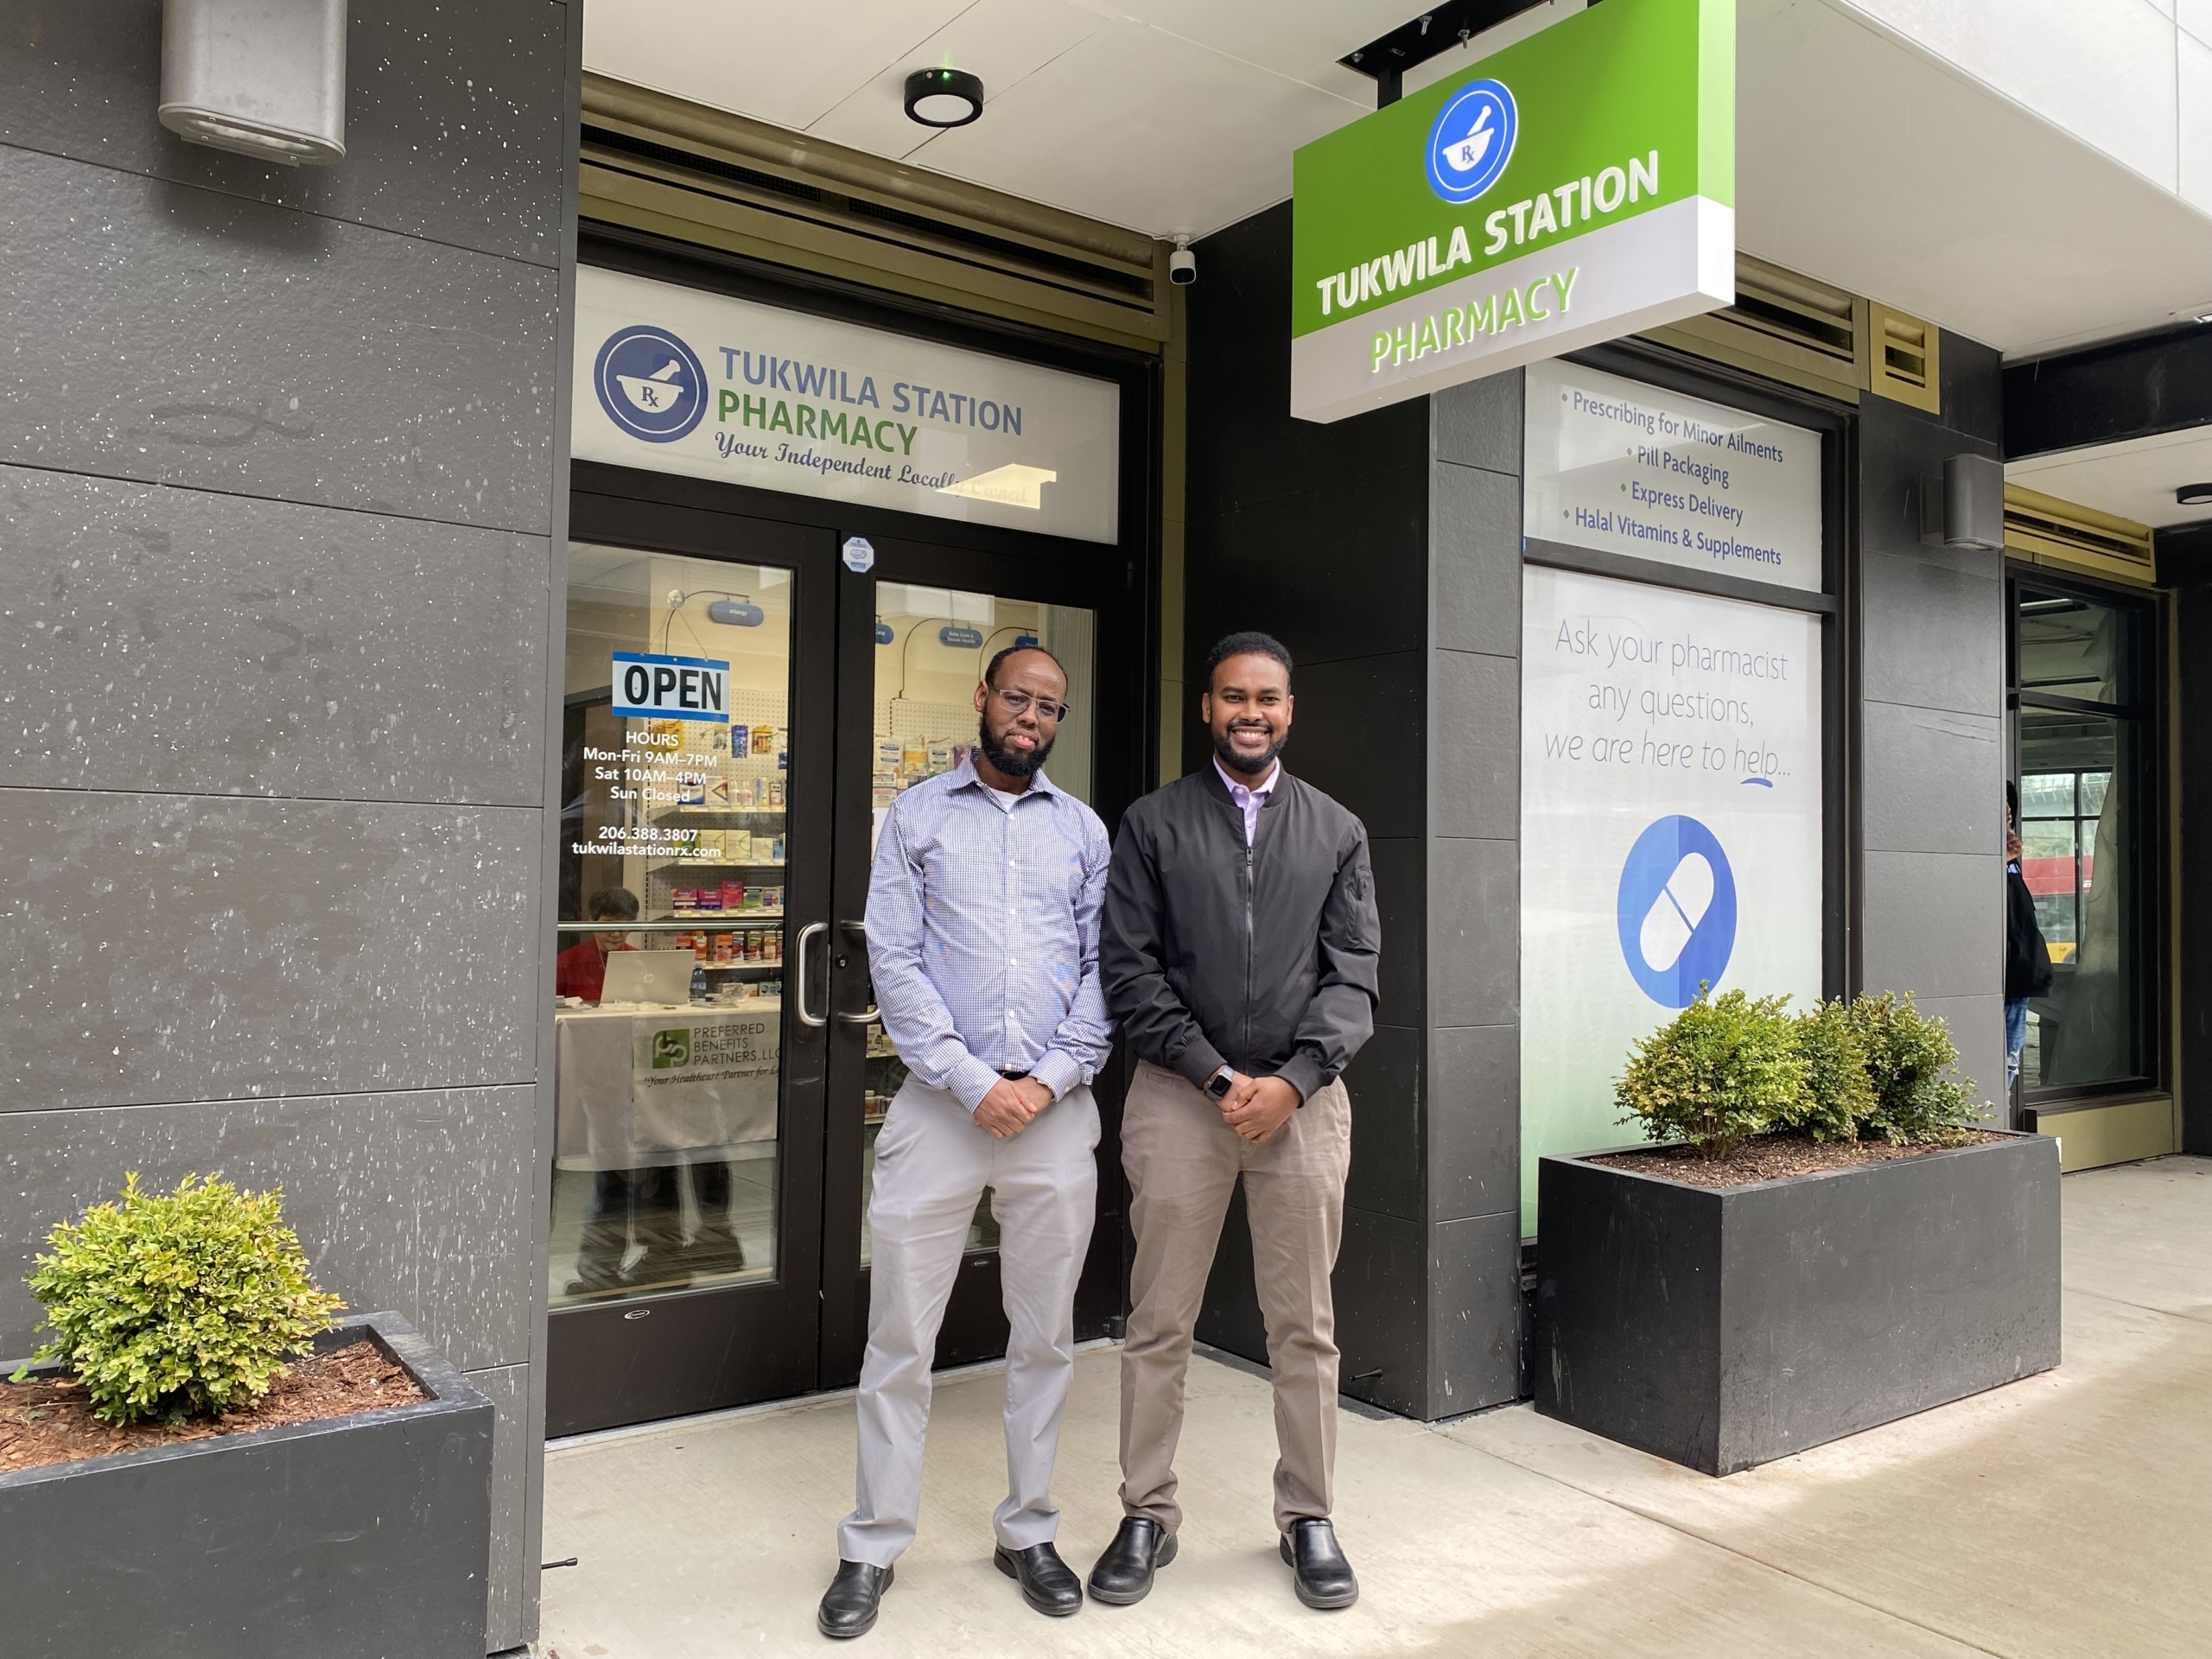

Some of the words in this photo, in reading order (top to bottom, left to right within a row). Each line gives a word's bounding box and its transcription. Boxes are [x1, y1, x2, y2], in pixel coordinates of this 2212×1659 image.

[1316, 226, 1471, 315] TUKWILA
[1484, 150, 1658, 255] STATION
[1370, 267, 1580, 373] PHARMACY
[719, 346, 880, 409] TUKWILA
[893, 383, 1022, 436] STATION
[718, 389, 918, 456] PHARMACY
[1573, 391, 1655, 435] Prescribing
[1658, 411, 1680, 435] for
[1683, 420, 1724, 447] Minor
[1727, 432, 1783, 463] Ailments
[715, 431, 768, 459] Your
[774, 442, 892, 480] Independent
[1637, 445, 1659, 468] Pill
[1663, 451, 1729, 490] Packaging
[1631, 480, 1685, 510] Express
[1688, 493, 1744, 527] Delivery
[1575, 506, 1613, 533] Halal
[1617, 515, 1678, 545] Vitamins
[1682, 529, 1693, 549] &
[1697, 532, 1782, 565] Supplements
[1554, 618, 1599, 657] Ask
[1607, 633, 1663, 669] your
[1671, 632, 1789, 681] pharmacist
[624, 664, 721, 711] OPEN
[1588, 683, 1631, 722] any
[1640, 690, 1754, 729] questions,
[583, 747, 640, 763] Mon-Fri
[626, 731, 679, 747] HOURS
[1545, 733, 1584, 760] we
[1592, 737, 1633, 764] are
[1641, 729, 1694, 769] here
[1701, 741, 1726, 771] to
[594, 766, 619, 780] Sat
[610, 785, 638, 800] Sun
[642, 788, 690, 803] Closed
[572, 841, 721, 857] tukwilastationrx.com
[598, 826, 698, 842] 206.388.3807
[694, 1023, 765, 1039] PREFERRED
[694, 1038, 748, 1052] BENEFITS
[672, 1071, 720, 1084] Healthcare
[722, 1069, 754, 1079] Partner
[755, 1065, 768, 1079] for
[694, 1051, 760, 1066] PARTNERS,
